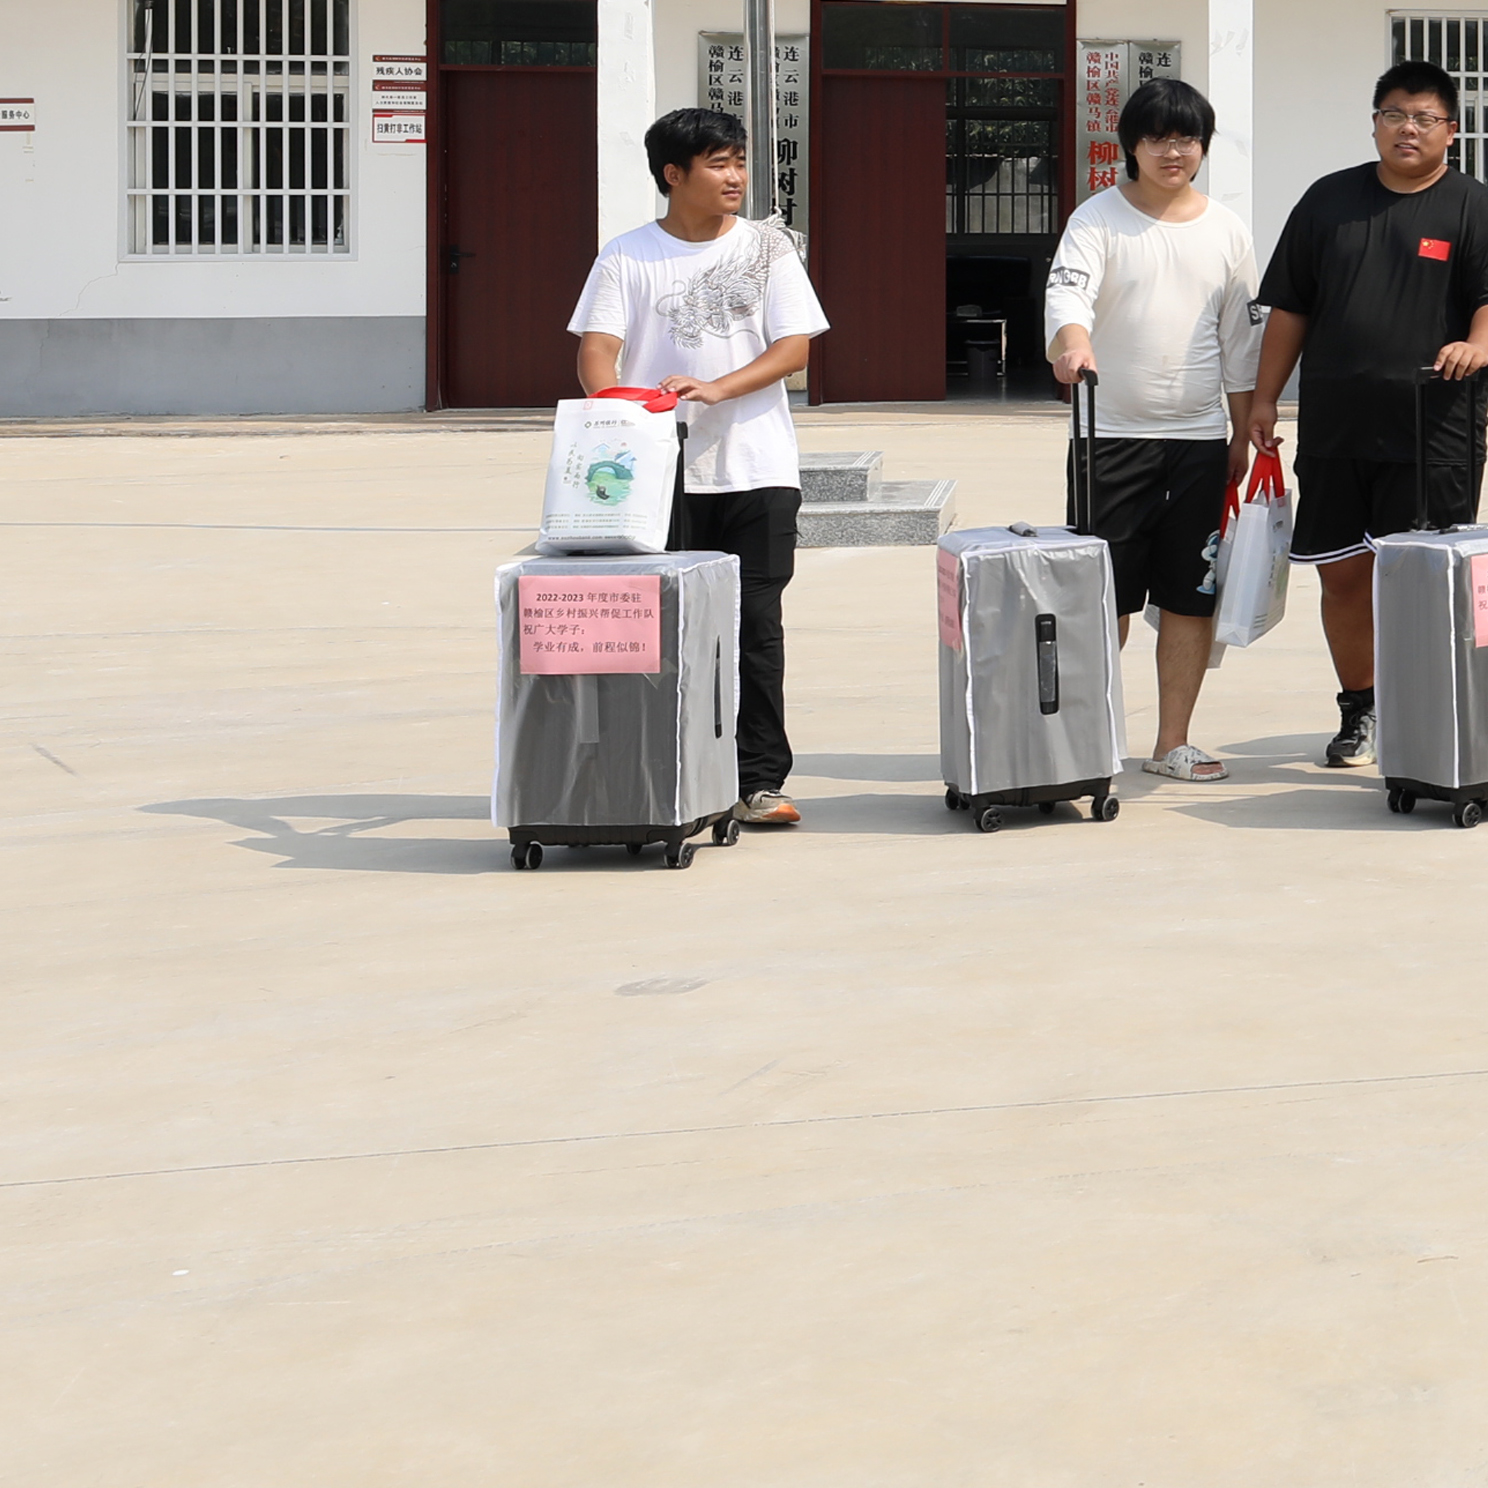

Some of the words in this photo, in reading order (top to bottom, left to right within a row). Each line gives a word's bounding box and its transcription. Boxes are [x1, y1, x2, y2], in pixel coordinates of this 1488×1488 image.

[376, 66, 423, 76] 残疾人协会
[783, 46, 799, 129] 连云港市
[1086, 52, 1101, 132] 赣榆区赣马镇
[1105, 52, 1119, 132] 中国共产党连云港市
[523, 608, 654, 619] 赣榆区乡村振兴帮促工作队
[536, 593, 584, 602] 2022-2023
[587, 592, 642, 603] 年度市委驻
